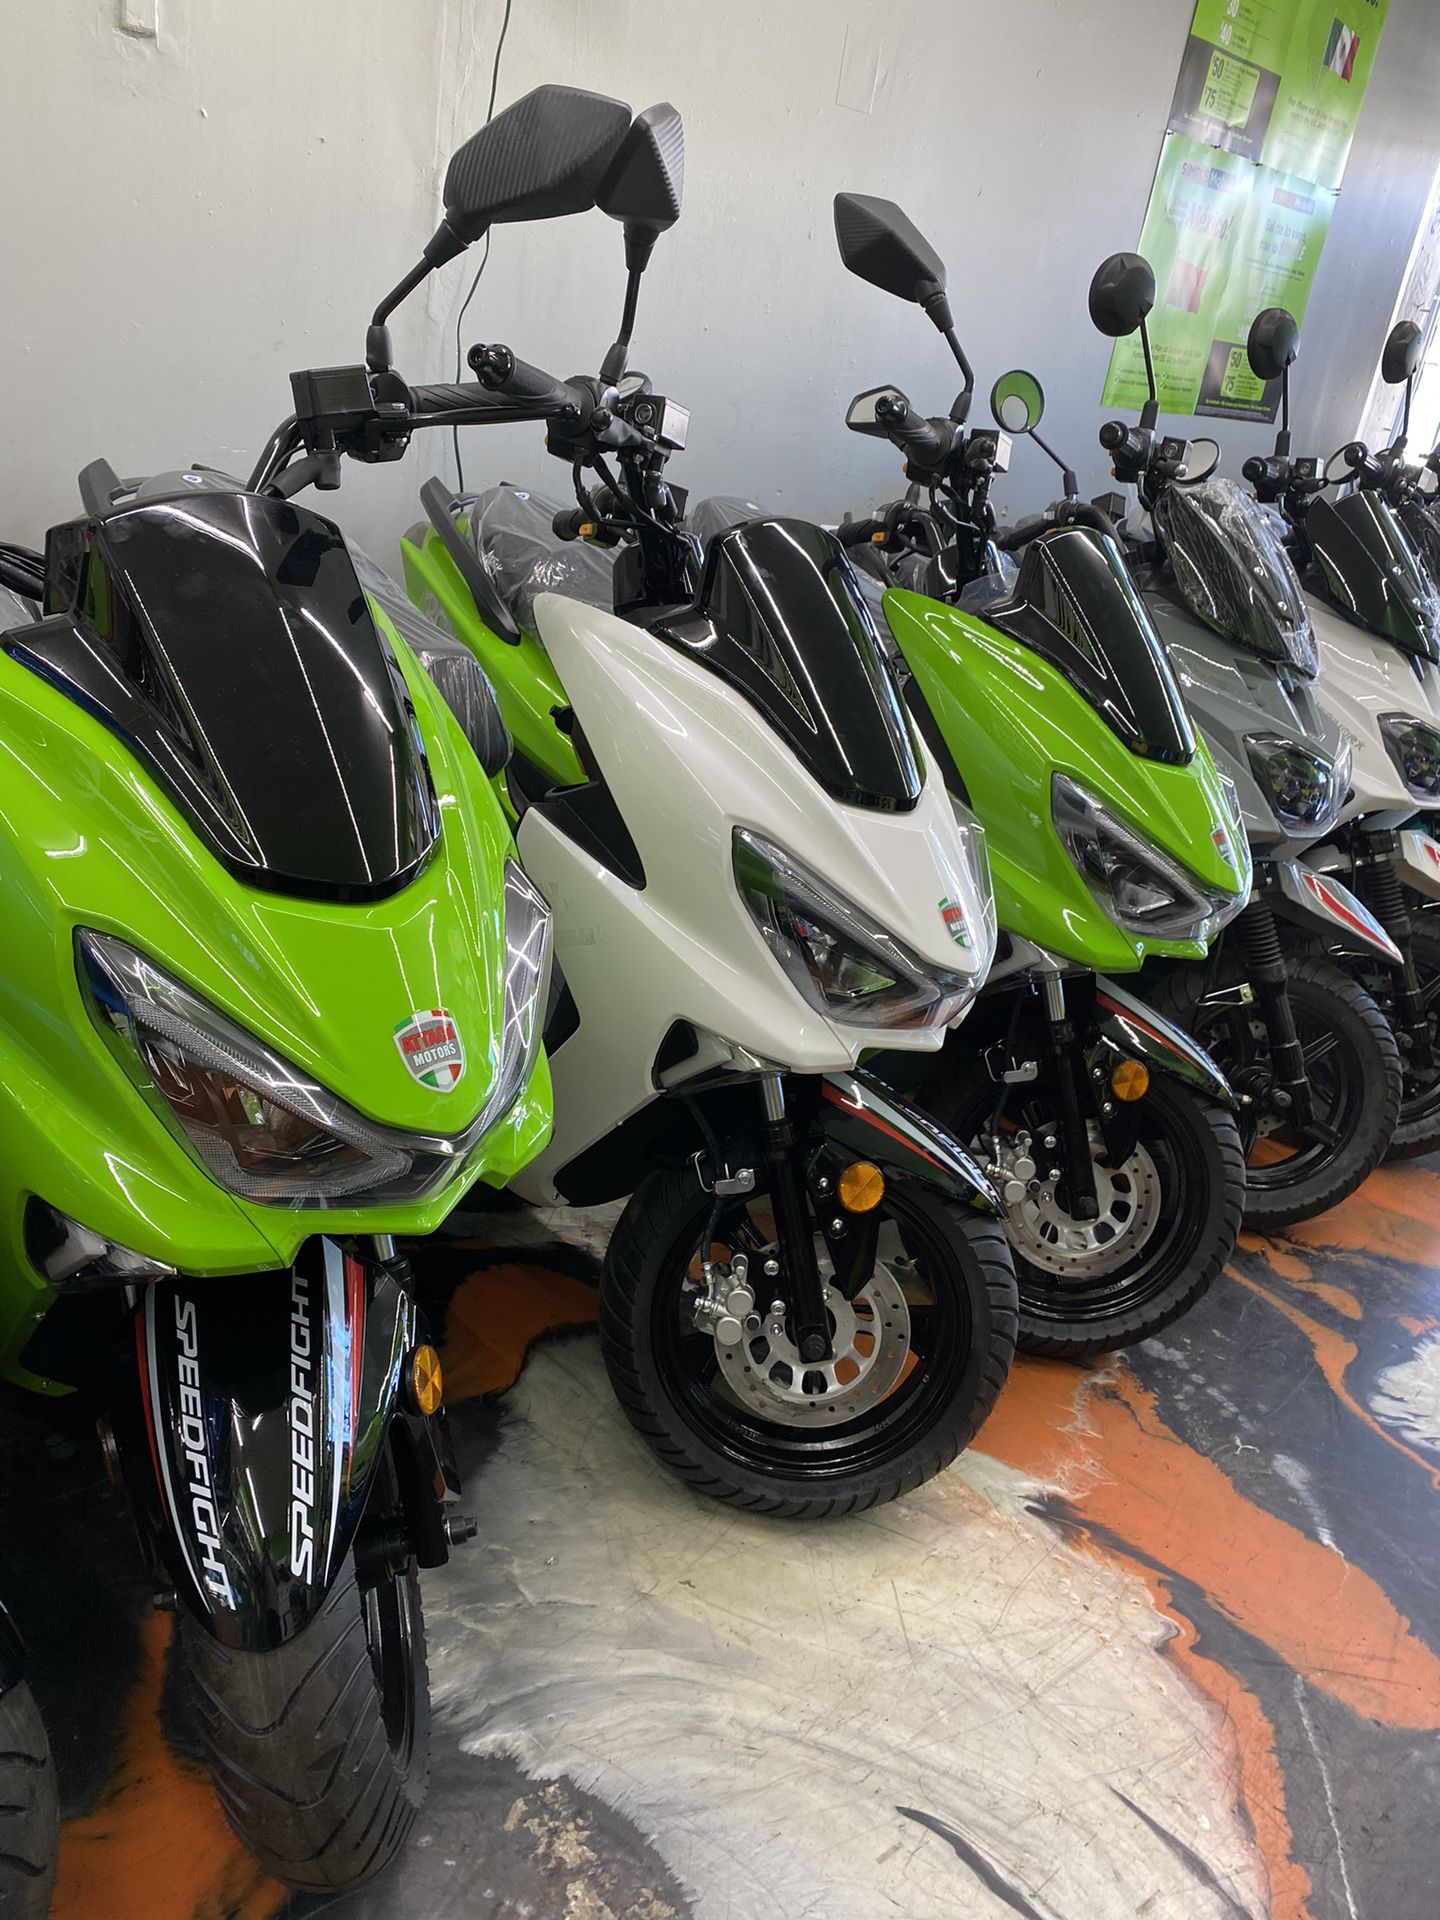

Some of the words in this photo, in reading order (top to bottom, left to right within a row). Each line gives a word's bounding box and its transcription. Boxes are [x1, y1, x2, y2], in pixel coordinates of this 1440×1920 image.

[401, 1022, 457, 1055] ATTACK
[412, 1042, 457, 1067] MOTORS
[174, 1294, 237, 1612] SPEEDFIGHT
[290, 1264, 316, 1586] SPEEDFIGHT
